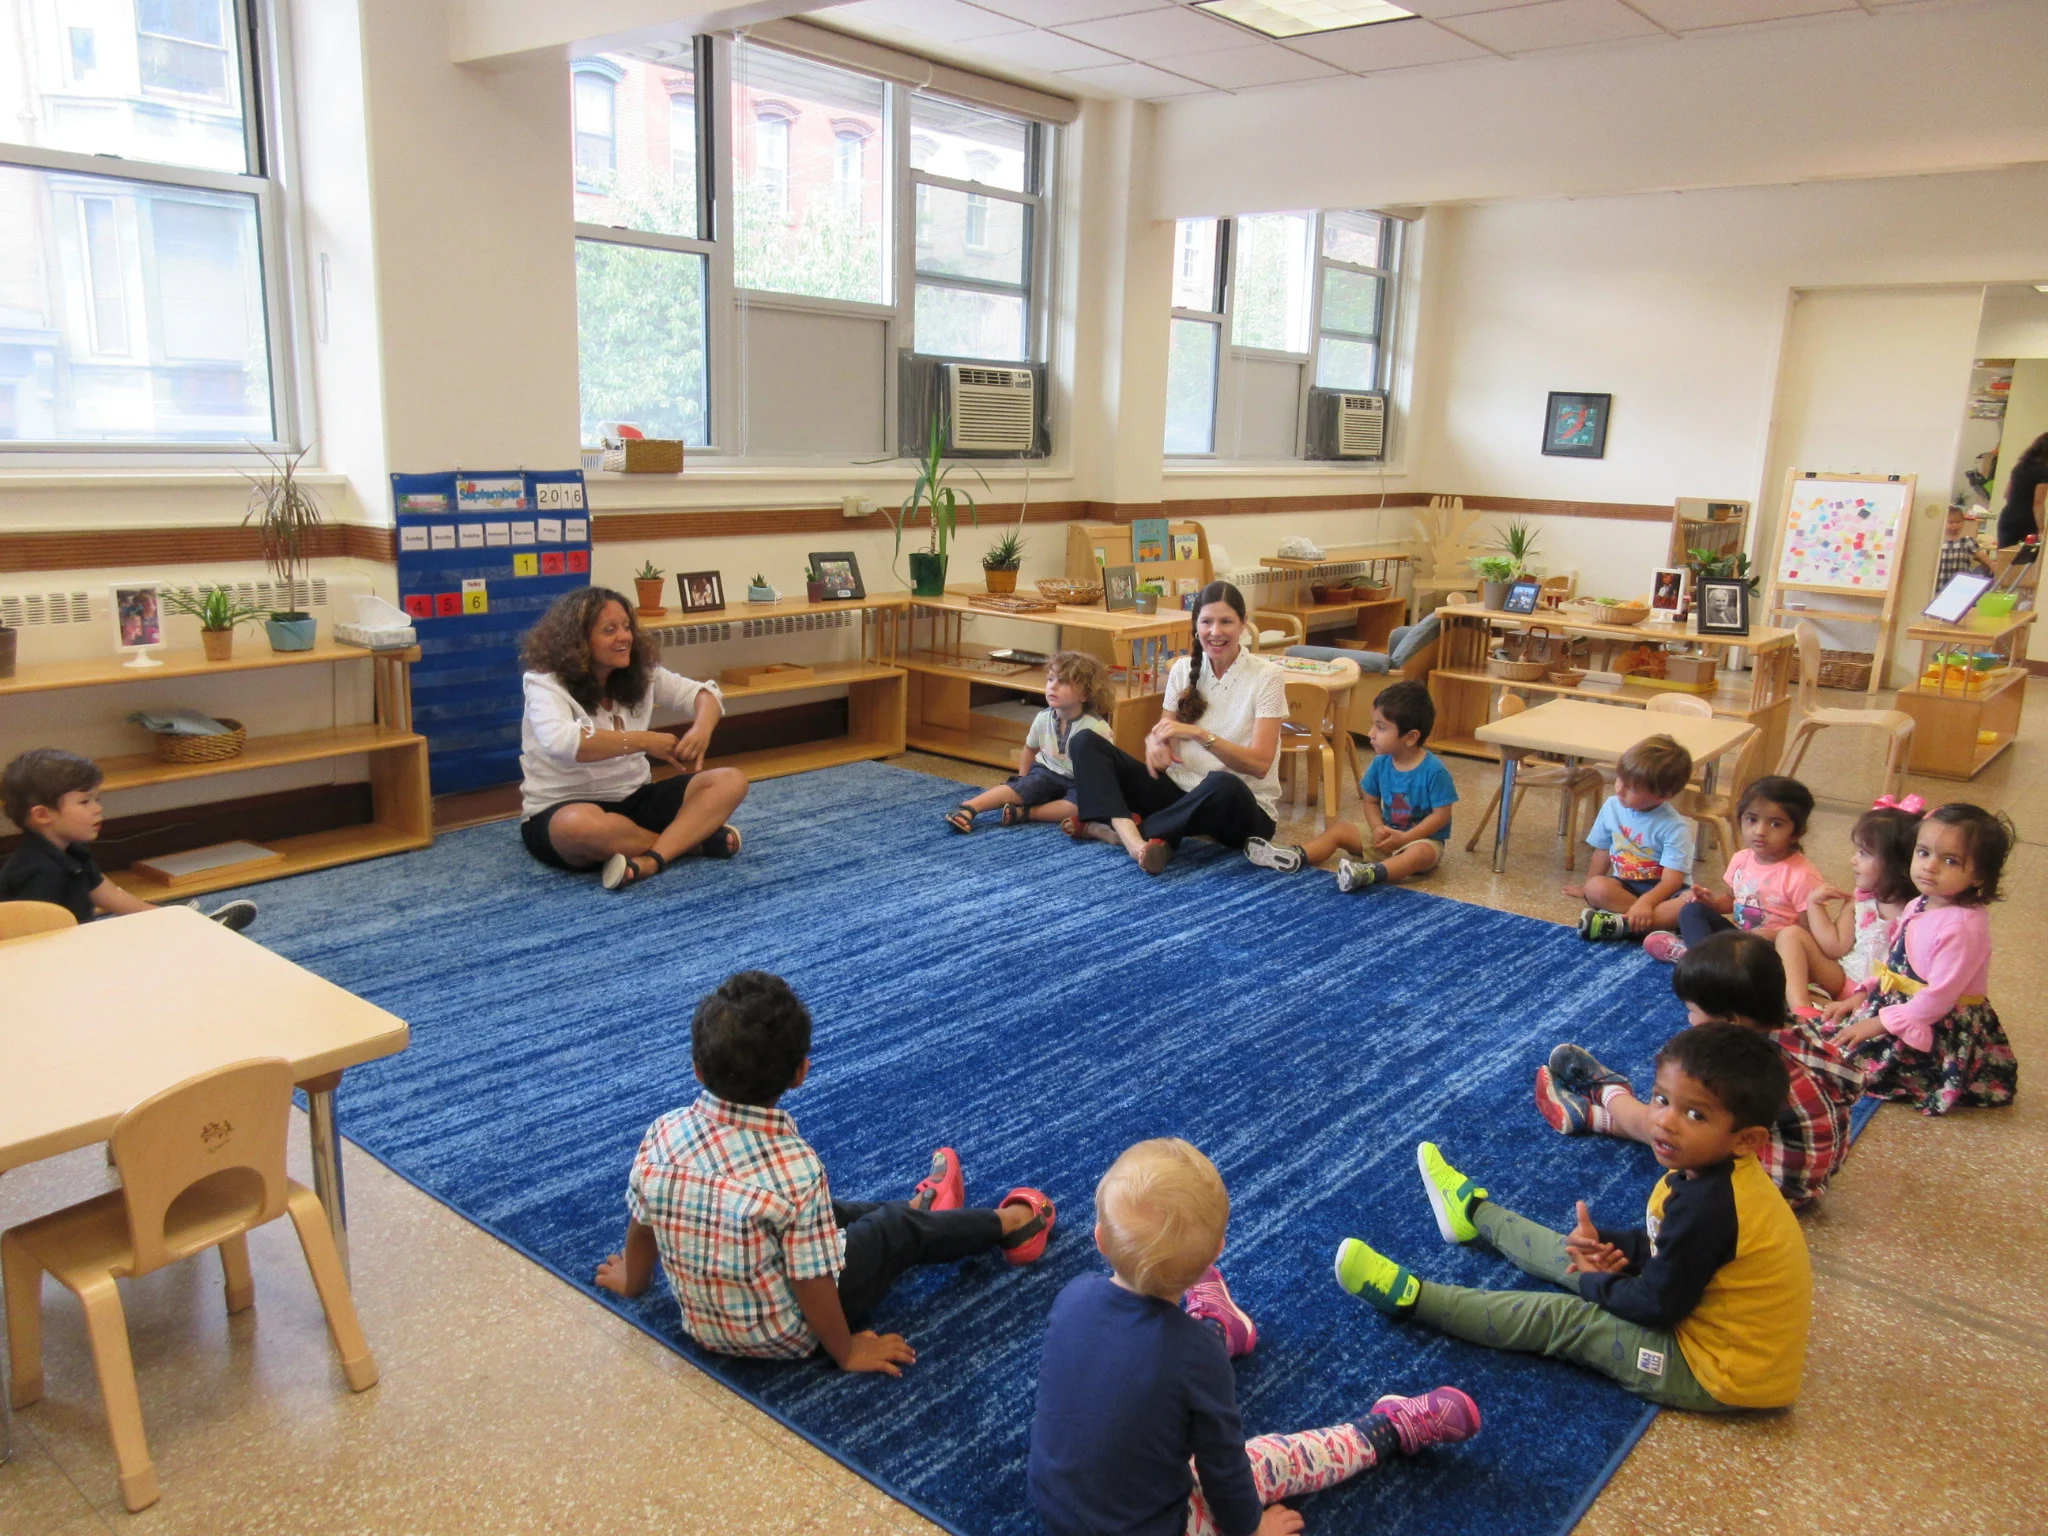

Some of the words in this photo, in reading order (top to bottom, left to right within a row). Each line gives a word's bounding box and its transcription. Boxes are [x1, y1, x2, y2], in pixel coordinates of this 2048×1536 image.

[459, 487, 522, 503] September
[539, 489, 582, 503] 2016
[523, 559, 529, 572] 1
[549, 557, 557, 570] 2
[574, 554, 581, 568] 3
[413, 601, 423, 613] 4
[444, 599, 453, 611] 5
[472, 596, 481, 609] 6
